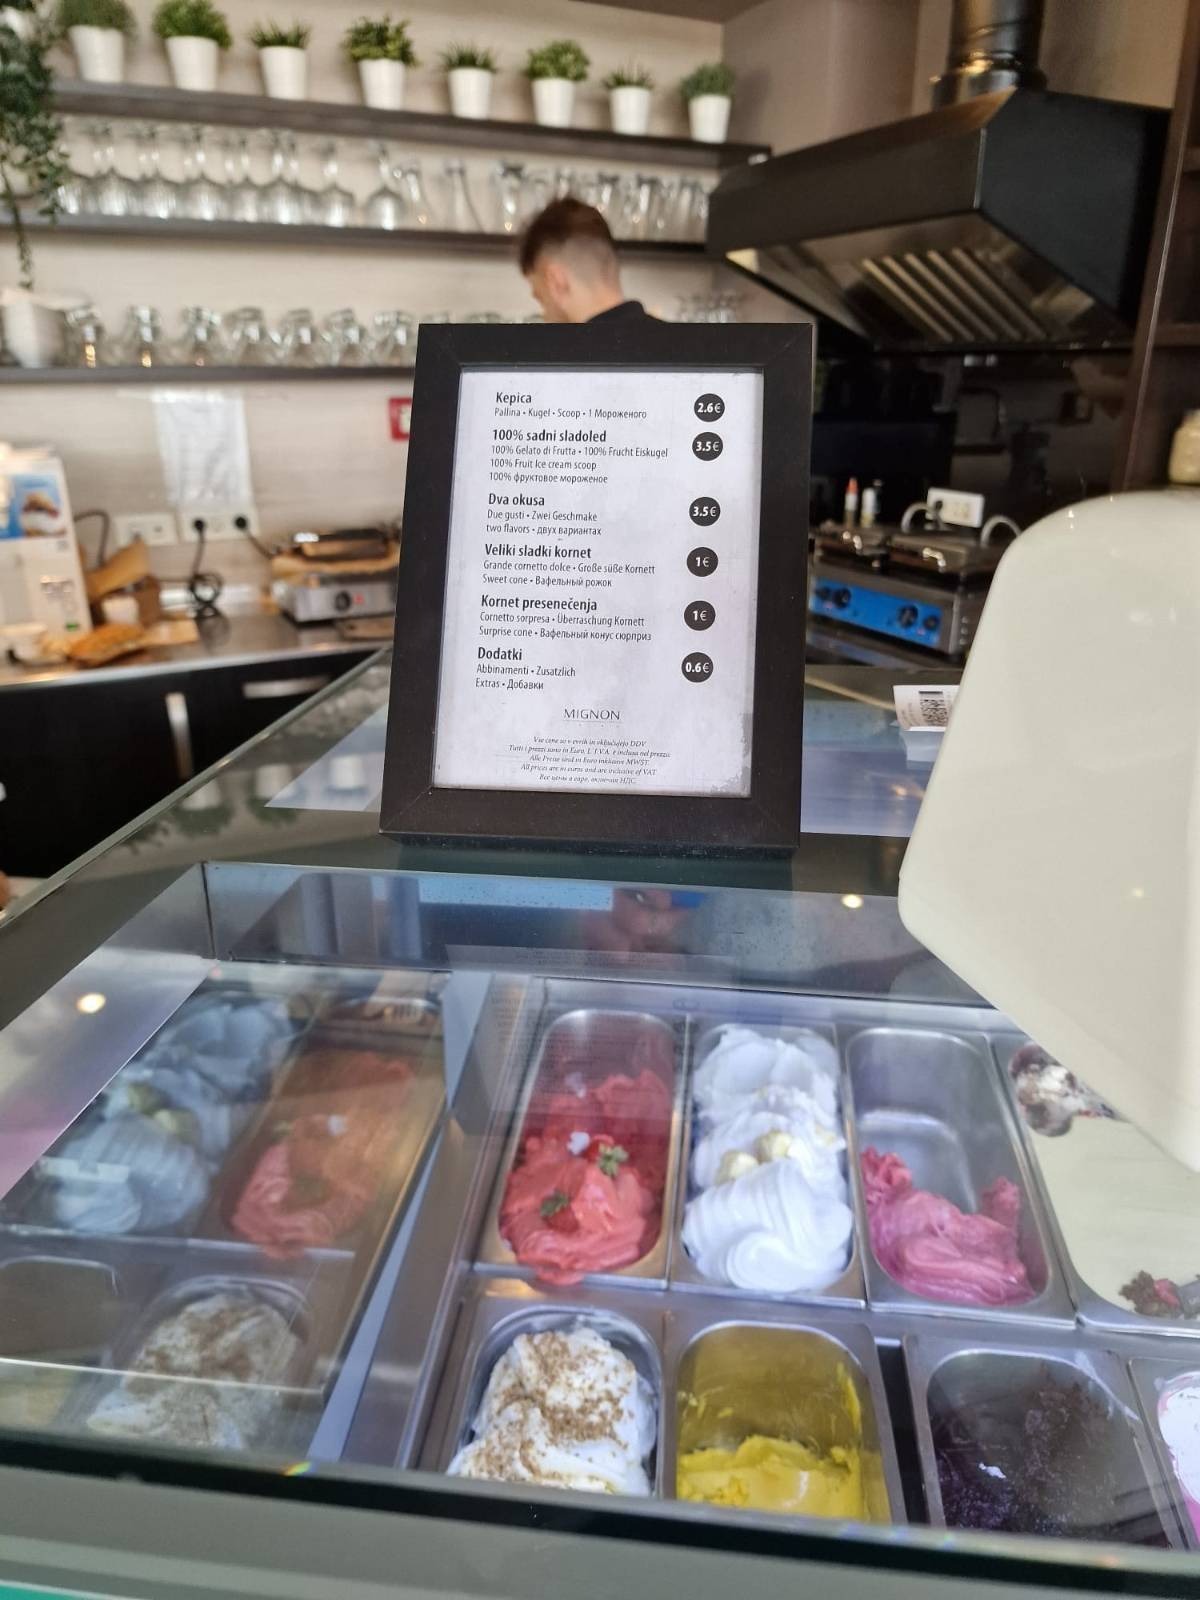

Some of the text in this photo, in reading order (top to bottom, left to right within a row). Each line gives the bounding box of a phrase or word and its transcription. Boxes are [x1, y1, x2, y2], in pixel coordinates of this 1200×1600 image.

[496, 392, 532, 406] Kepica
[494, 407, 521, 418] Pallina
[528, 408, 550, 419] Kugel
[557, 408, 581, 420] Scoop
[594, 408, 647, 420] Мороженого
[697, 402, 721, 414] 2.6€
[492, 429, 606, 442] 100% sadni sladoled
[492, 445, 668, 459] 100% Gelato di Frutta 100% Frucht Eiskugel
[490, 458, 597, 471] 100% Fruit Ice cream scoop
[490, 472, 608, 484] 100% фруктовое мороженое
[488, 493, 545, 506] Dva okusa
[487, 509, 598, 522] Due gusti Zwei Geschmake
[692, 506, 717, 517] 3.5€
[486, 524, 602, 536] two flavors двух вариантах
[484, 544, 592, 559] Veliki sladki kornet
[483, 560, 656, 574] Grande cornetto dolce Große süße Kornett
[695, 556, 710, 568] 1€
[482, 574, 612, 588] Sweet cone Вафельный рожок
[481, 594, 598, 614] Kornet presenečenja
[480, 611, 644, 628] Cornetto sorpresa Überraschung Kornett
[692, 610, 708, 622] 1€
[479, 625, 652, 643] Surprise cone Вафельный конус сюрприз
[478, 646, 522, 661] Dodatki
[476, 664, 529, 676] Abbinamenti
[685, 662, 710, 674] 0.6€
[476, 678, 544, 690] Extras Добавки
[564, 708, 620, 720] MIGNON
